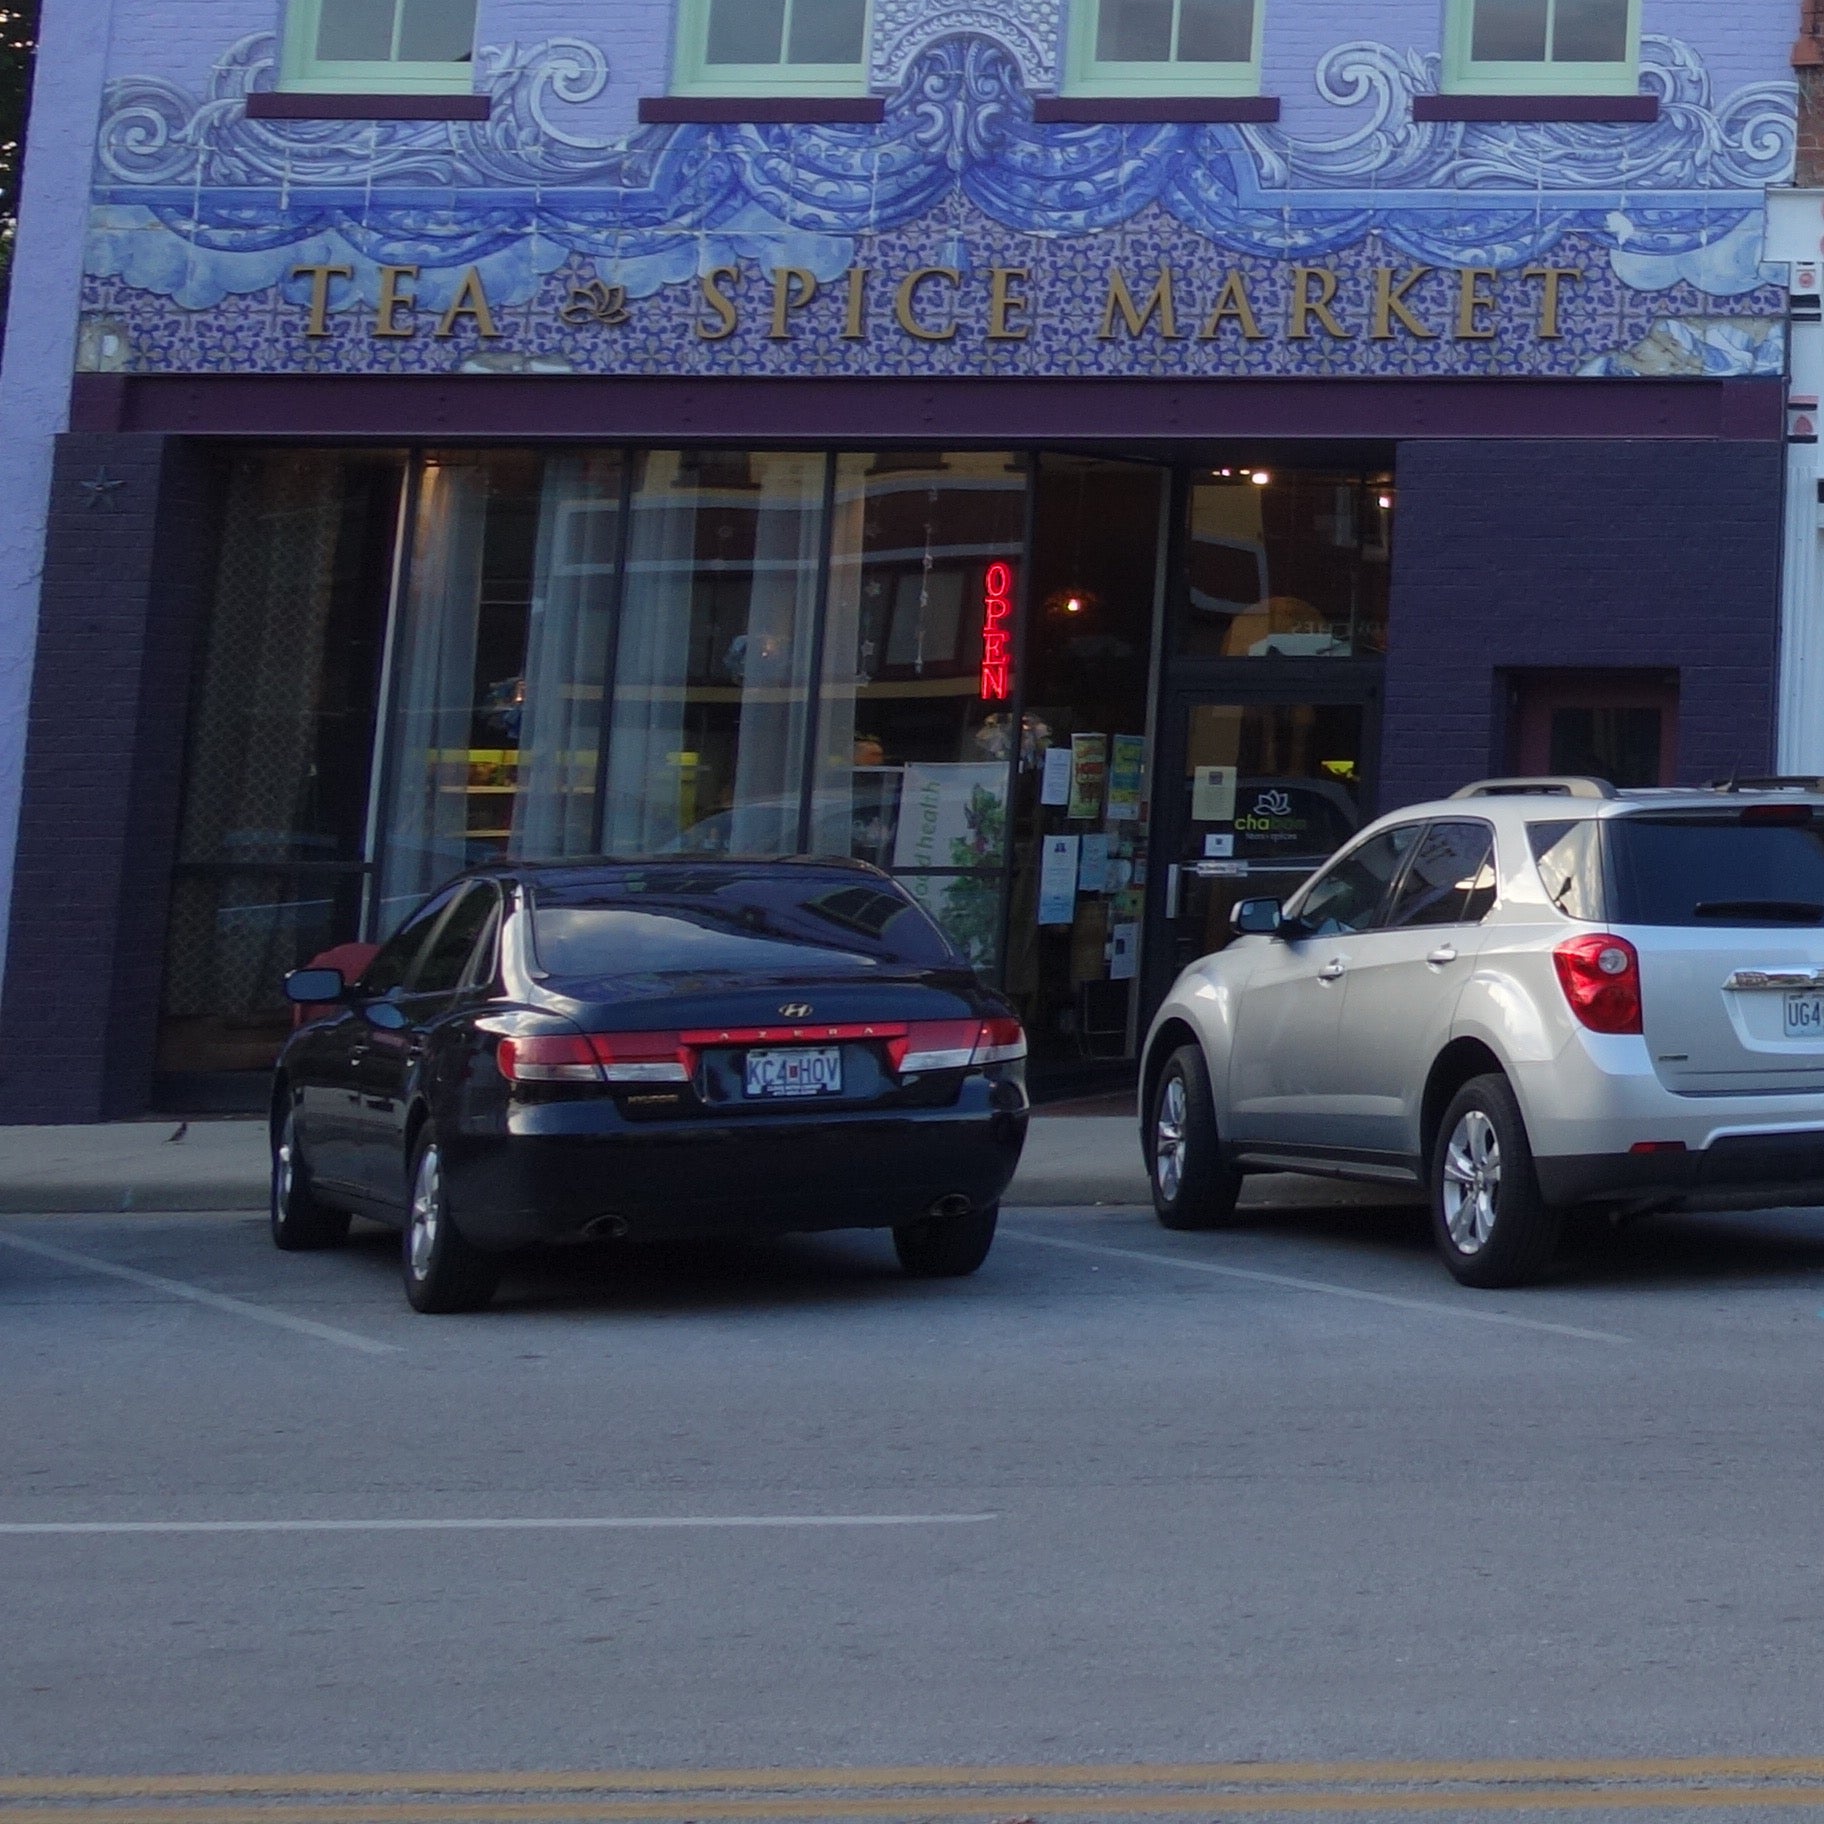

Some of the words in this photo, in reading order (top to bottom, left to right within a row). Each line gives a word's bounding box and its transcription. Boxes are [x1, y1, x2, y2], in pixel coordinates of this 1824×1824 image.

[292, 265, 501, 338] TEA
[696, 266, 1032, 340] SPICE
[1097, 267, 1582, 340] MARKET
[982, 563, 1010, 700] OPEN
[1788, 1001, 1820, 1027] UG4
